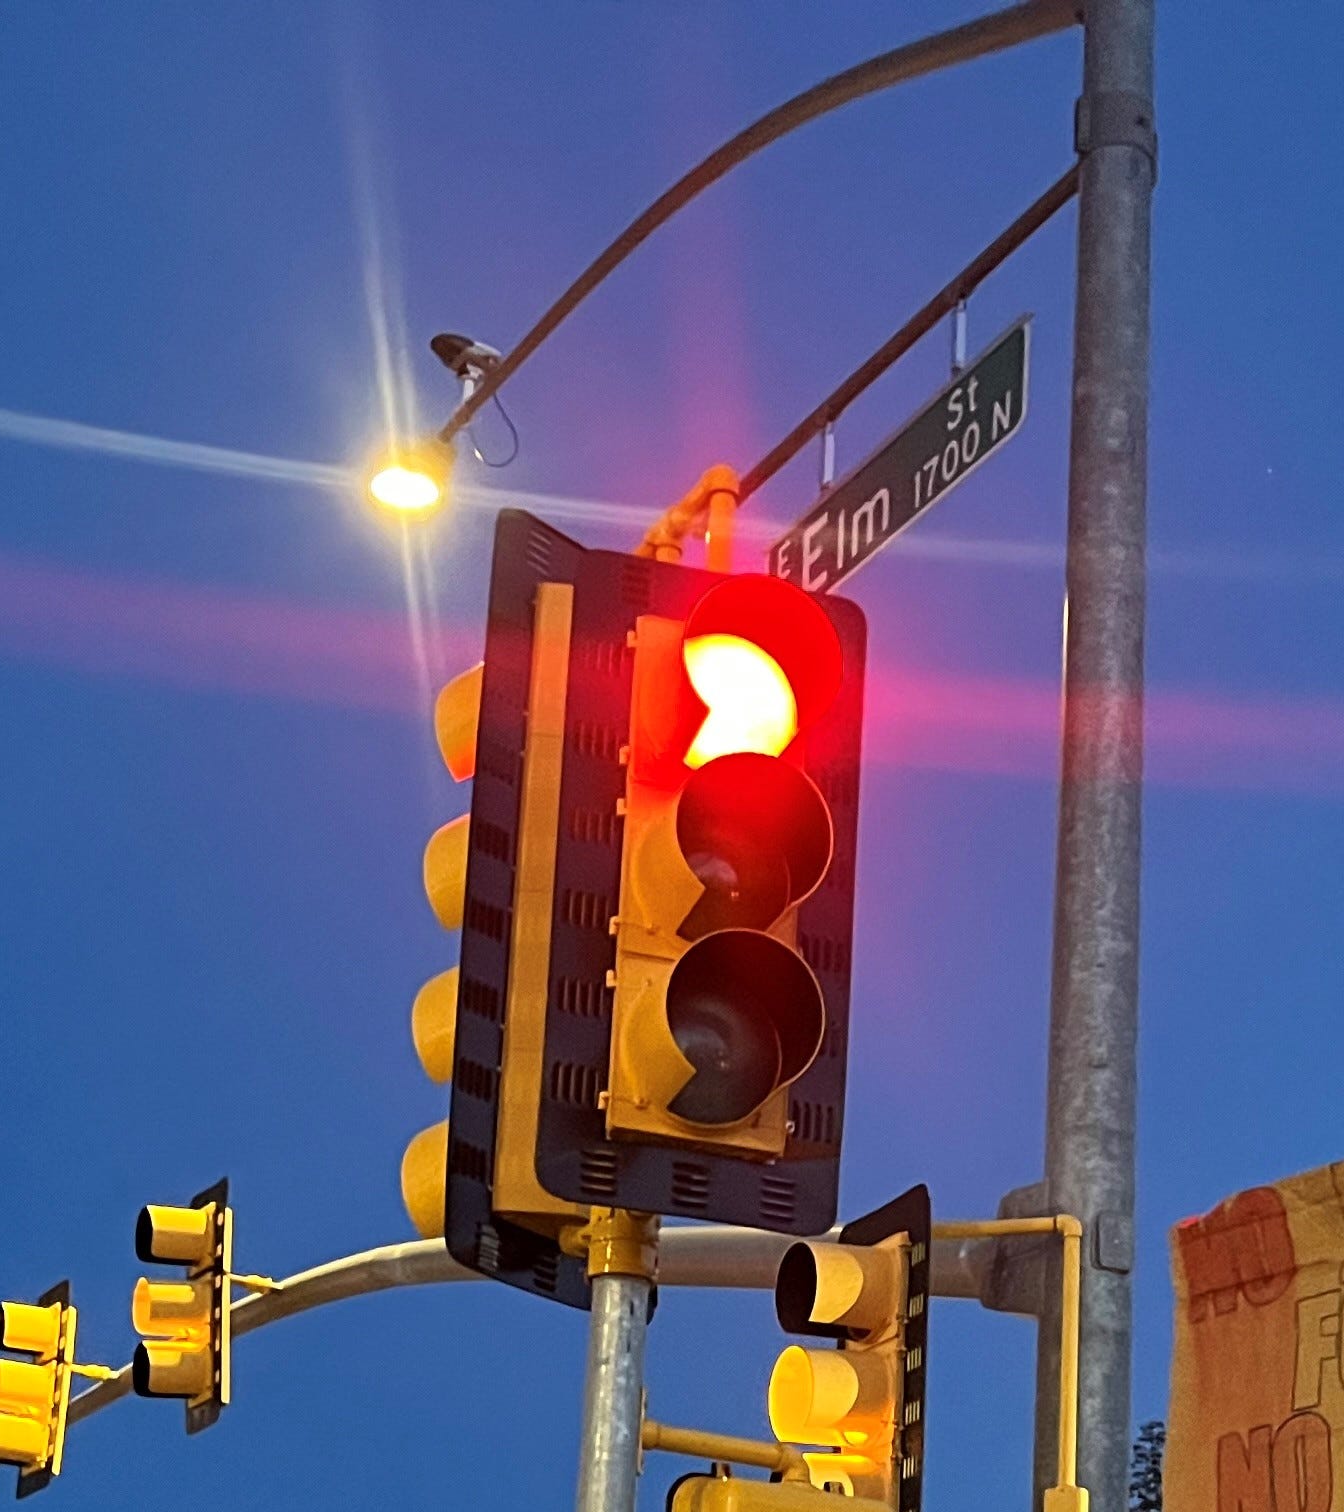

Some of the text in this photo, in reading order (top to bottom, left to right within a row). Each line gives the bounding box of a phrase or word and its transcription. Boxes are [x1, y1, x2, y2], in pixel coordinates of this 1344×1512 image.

[777, 374, 979, 592] E Elm St
[914, 390, 1012, 508] 1700 N
[1178, 1186, 1298, 1324] NO
